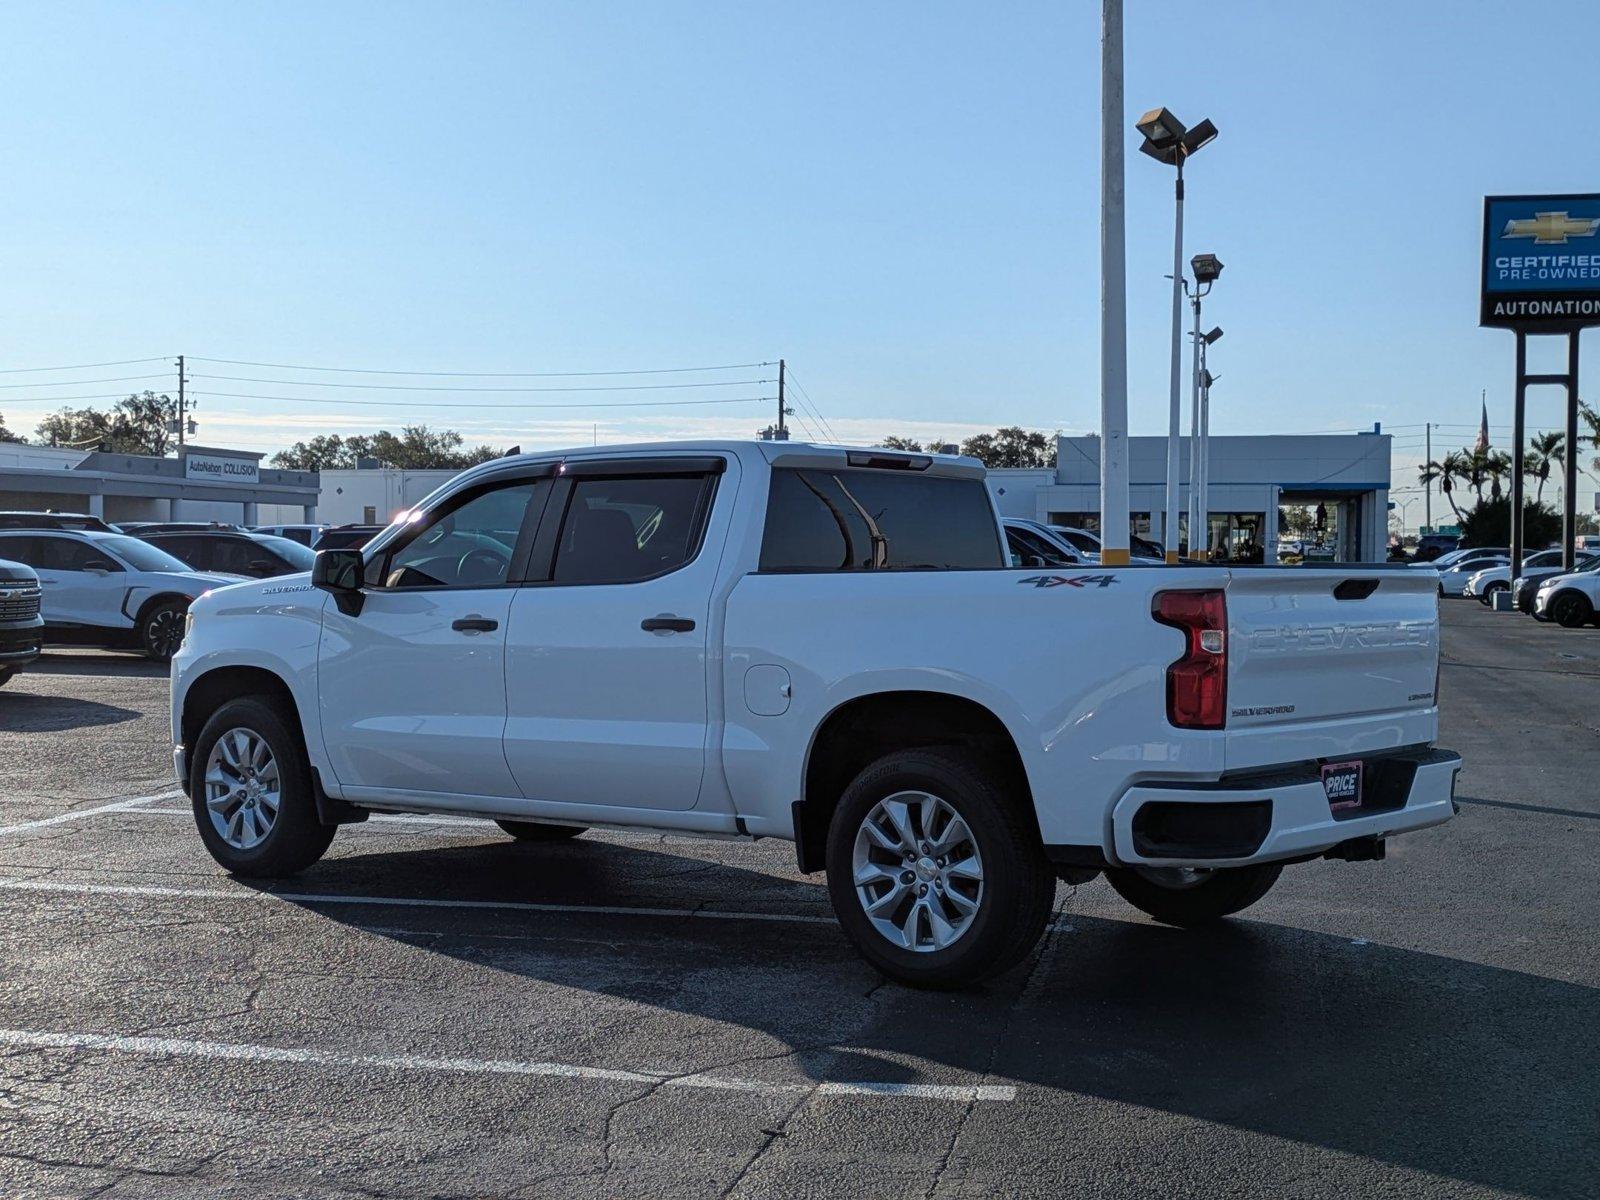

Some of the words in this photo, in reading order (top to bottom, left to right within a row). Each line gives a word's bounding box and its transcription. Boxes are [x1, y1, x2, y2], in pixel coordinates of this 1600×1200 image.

[1495, 256, 1600, 268] CERTIFIED
[1500, 268, 1600, 279] PRE-OWNED
[190, 460, 221, 472] AutoNation
[224, 462, 256, 476] COLLISION
